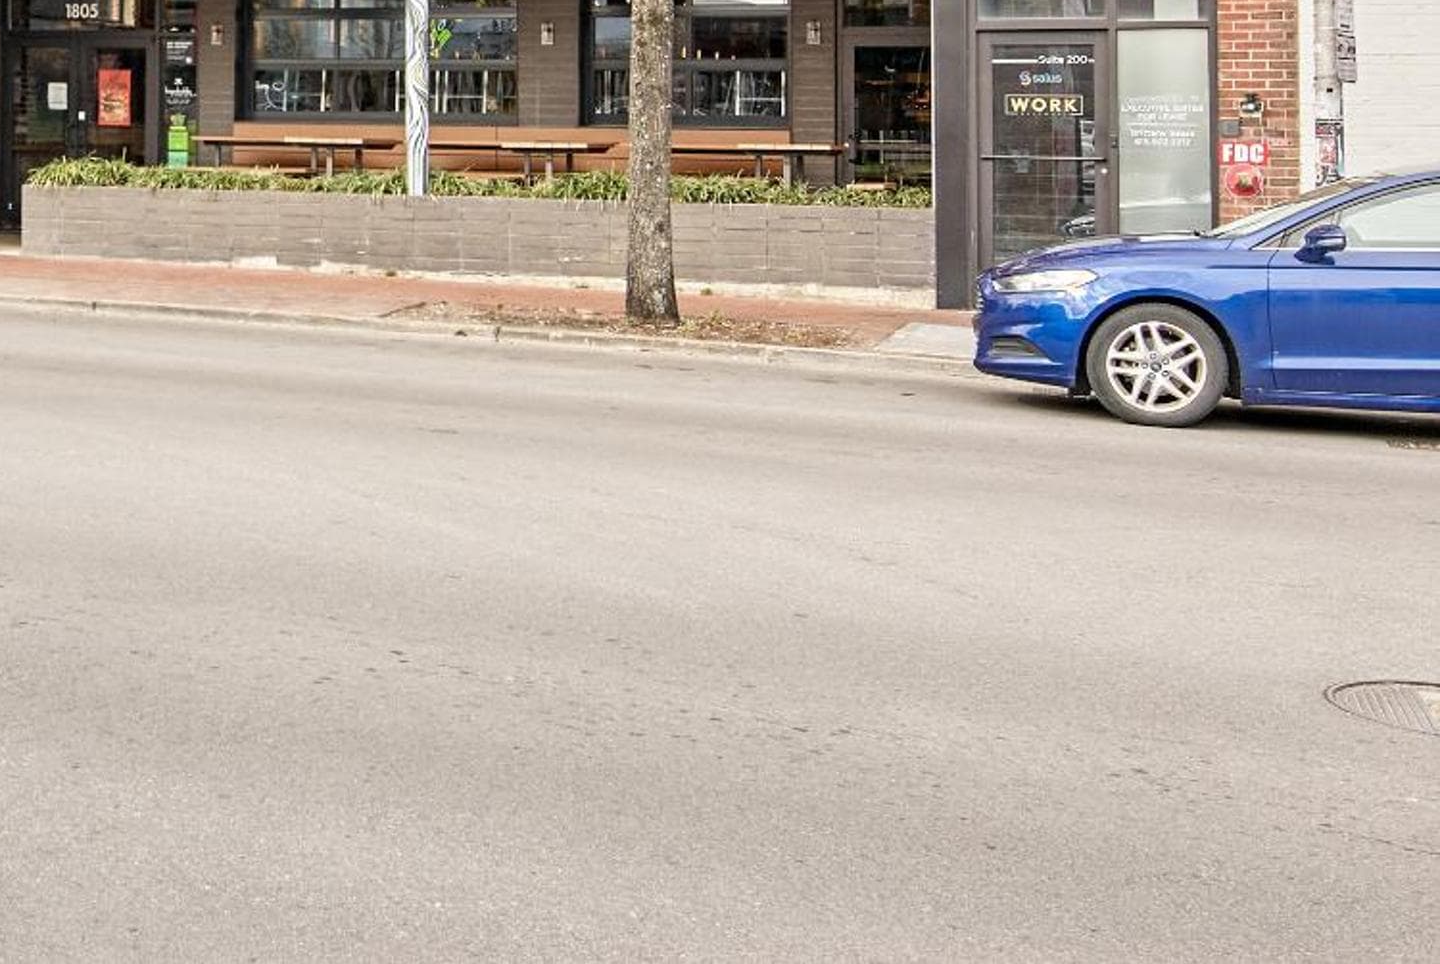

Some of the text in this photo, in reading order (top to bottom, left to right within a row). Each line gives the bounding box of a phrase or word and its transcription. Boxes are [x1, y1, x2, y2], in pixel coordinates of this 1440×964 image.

[65, 3, 98, 19] 1805
[1066, 55, 1088, 65] 200
[1010, 97, 1079, 113] WORK
[1221, 143, 1265, 163] FDC
